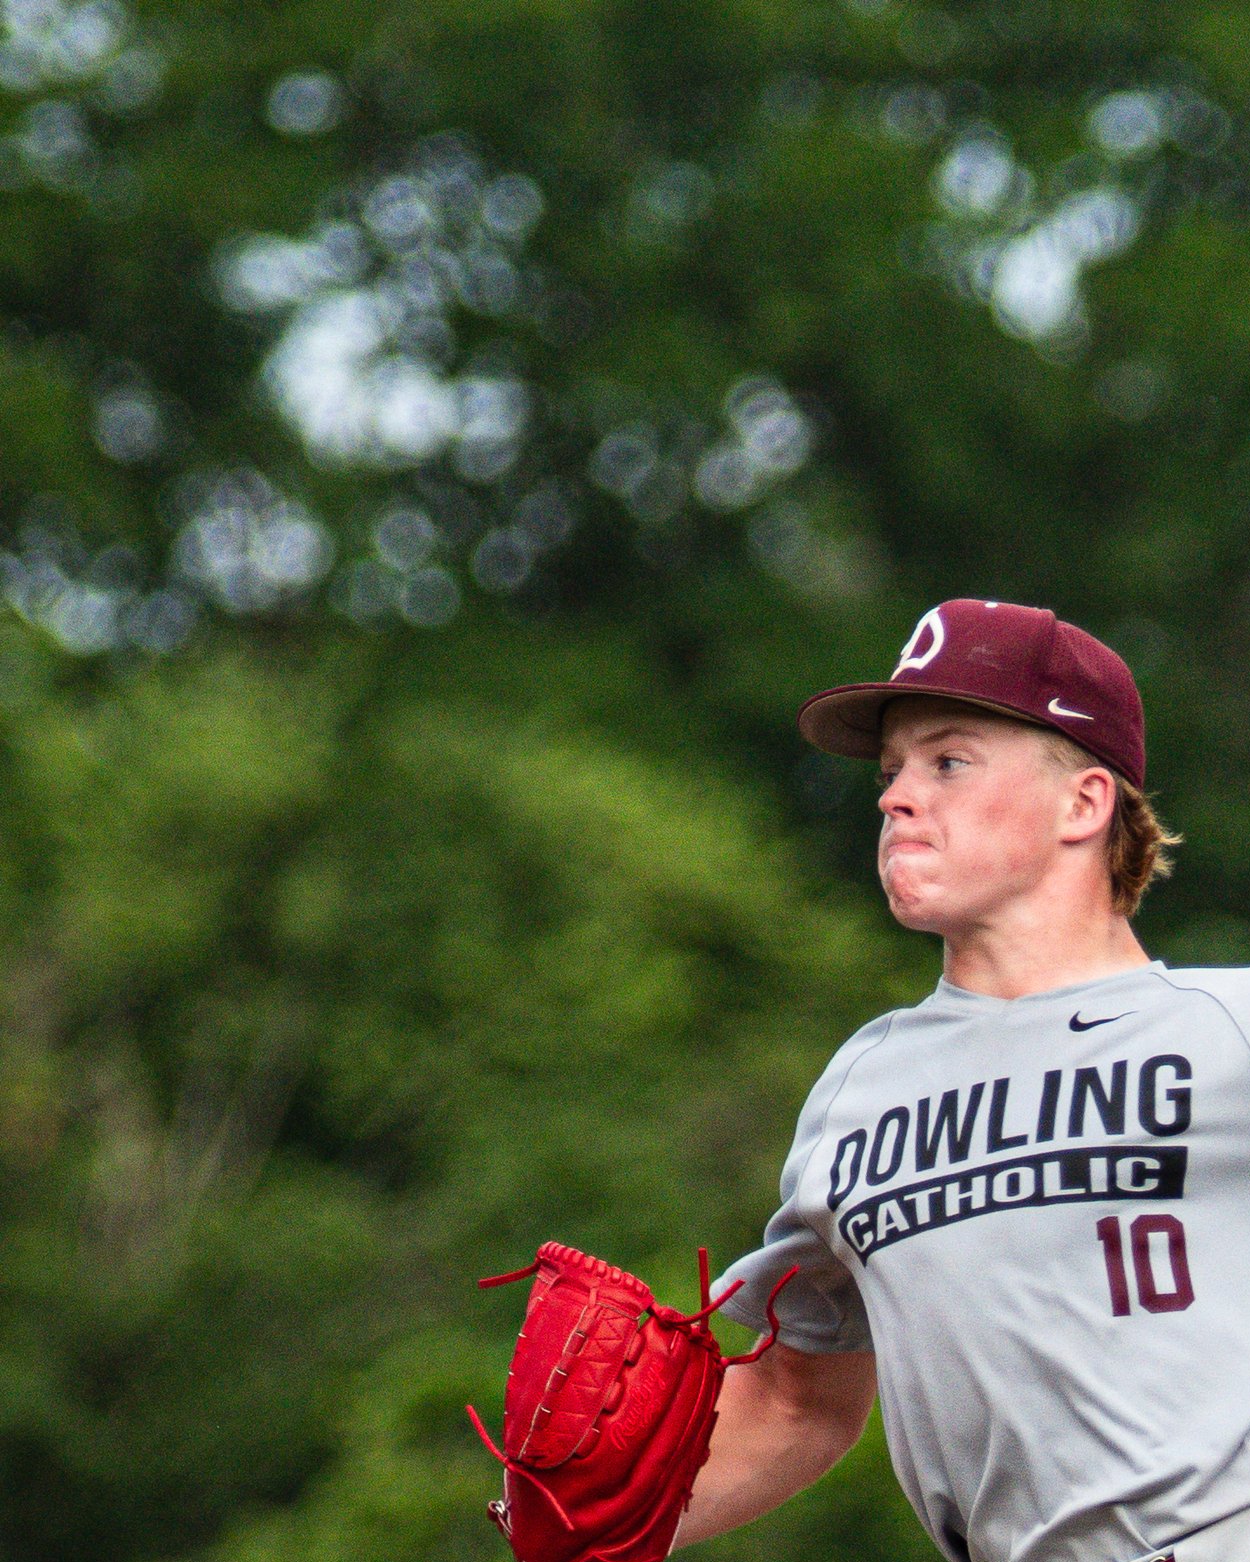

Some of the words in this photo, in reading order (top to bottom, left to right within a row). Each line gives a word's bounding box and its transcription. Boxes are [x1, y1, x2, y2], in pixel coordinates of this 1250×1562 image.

[827, 1054, 1193, 1211] DOWLING
[846, 1157, 1161, 1253] CATHOLIC
[1096, 1214, 1195, 1317] 10
